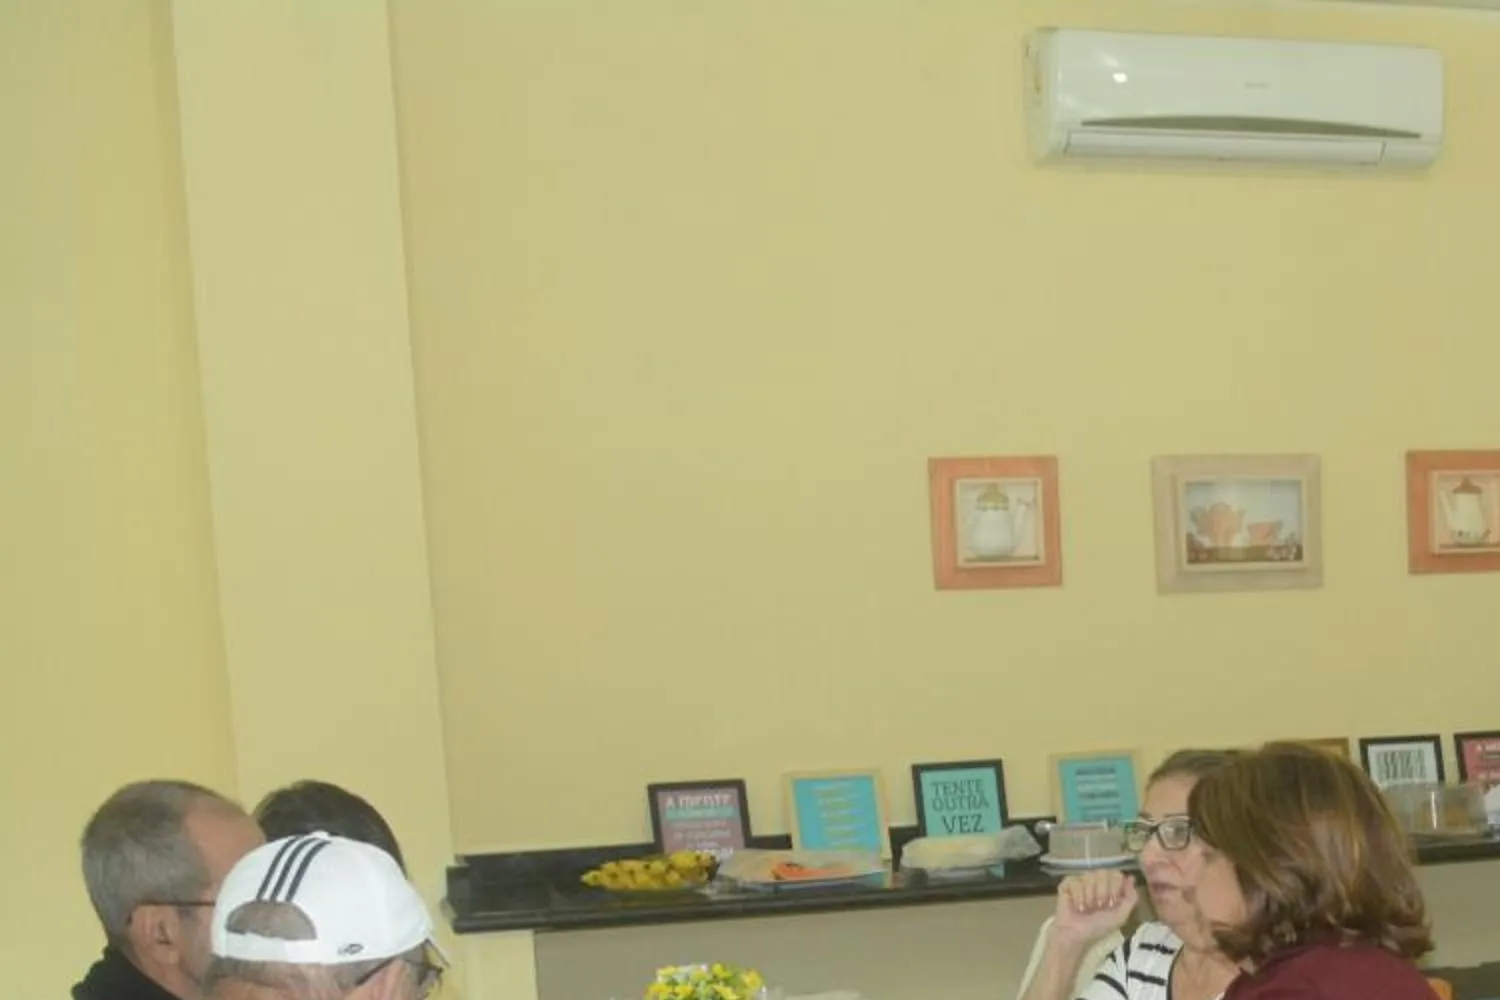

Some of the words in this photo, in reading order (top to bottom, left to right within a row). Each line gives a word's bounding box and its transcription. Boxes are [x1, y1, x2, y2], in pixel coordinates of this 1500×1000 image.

[931, 778, 985, 797] TENTE
[931, 790, 990, 812] OUTRA
[941, 813, 985, 834] VEZ
